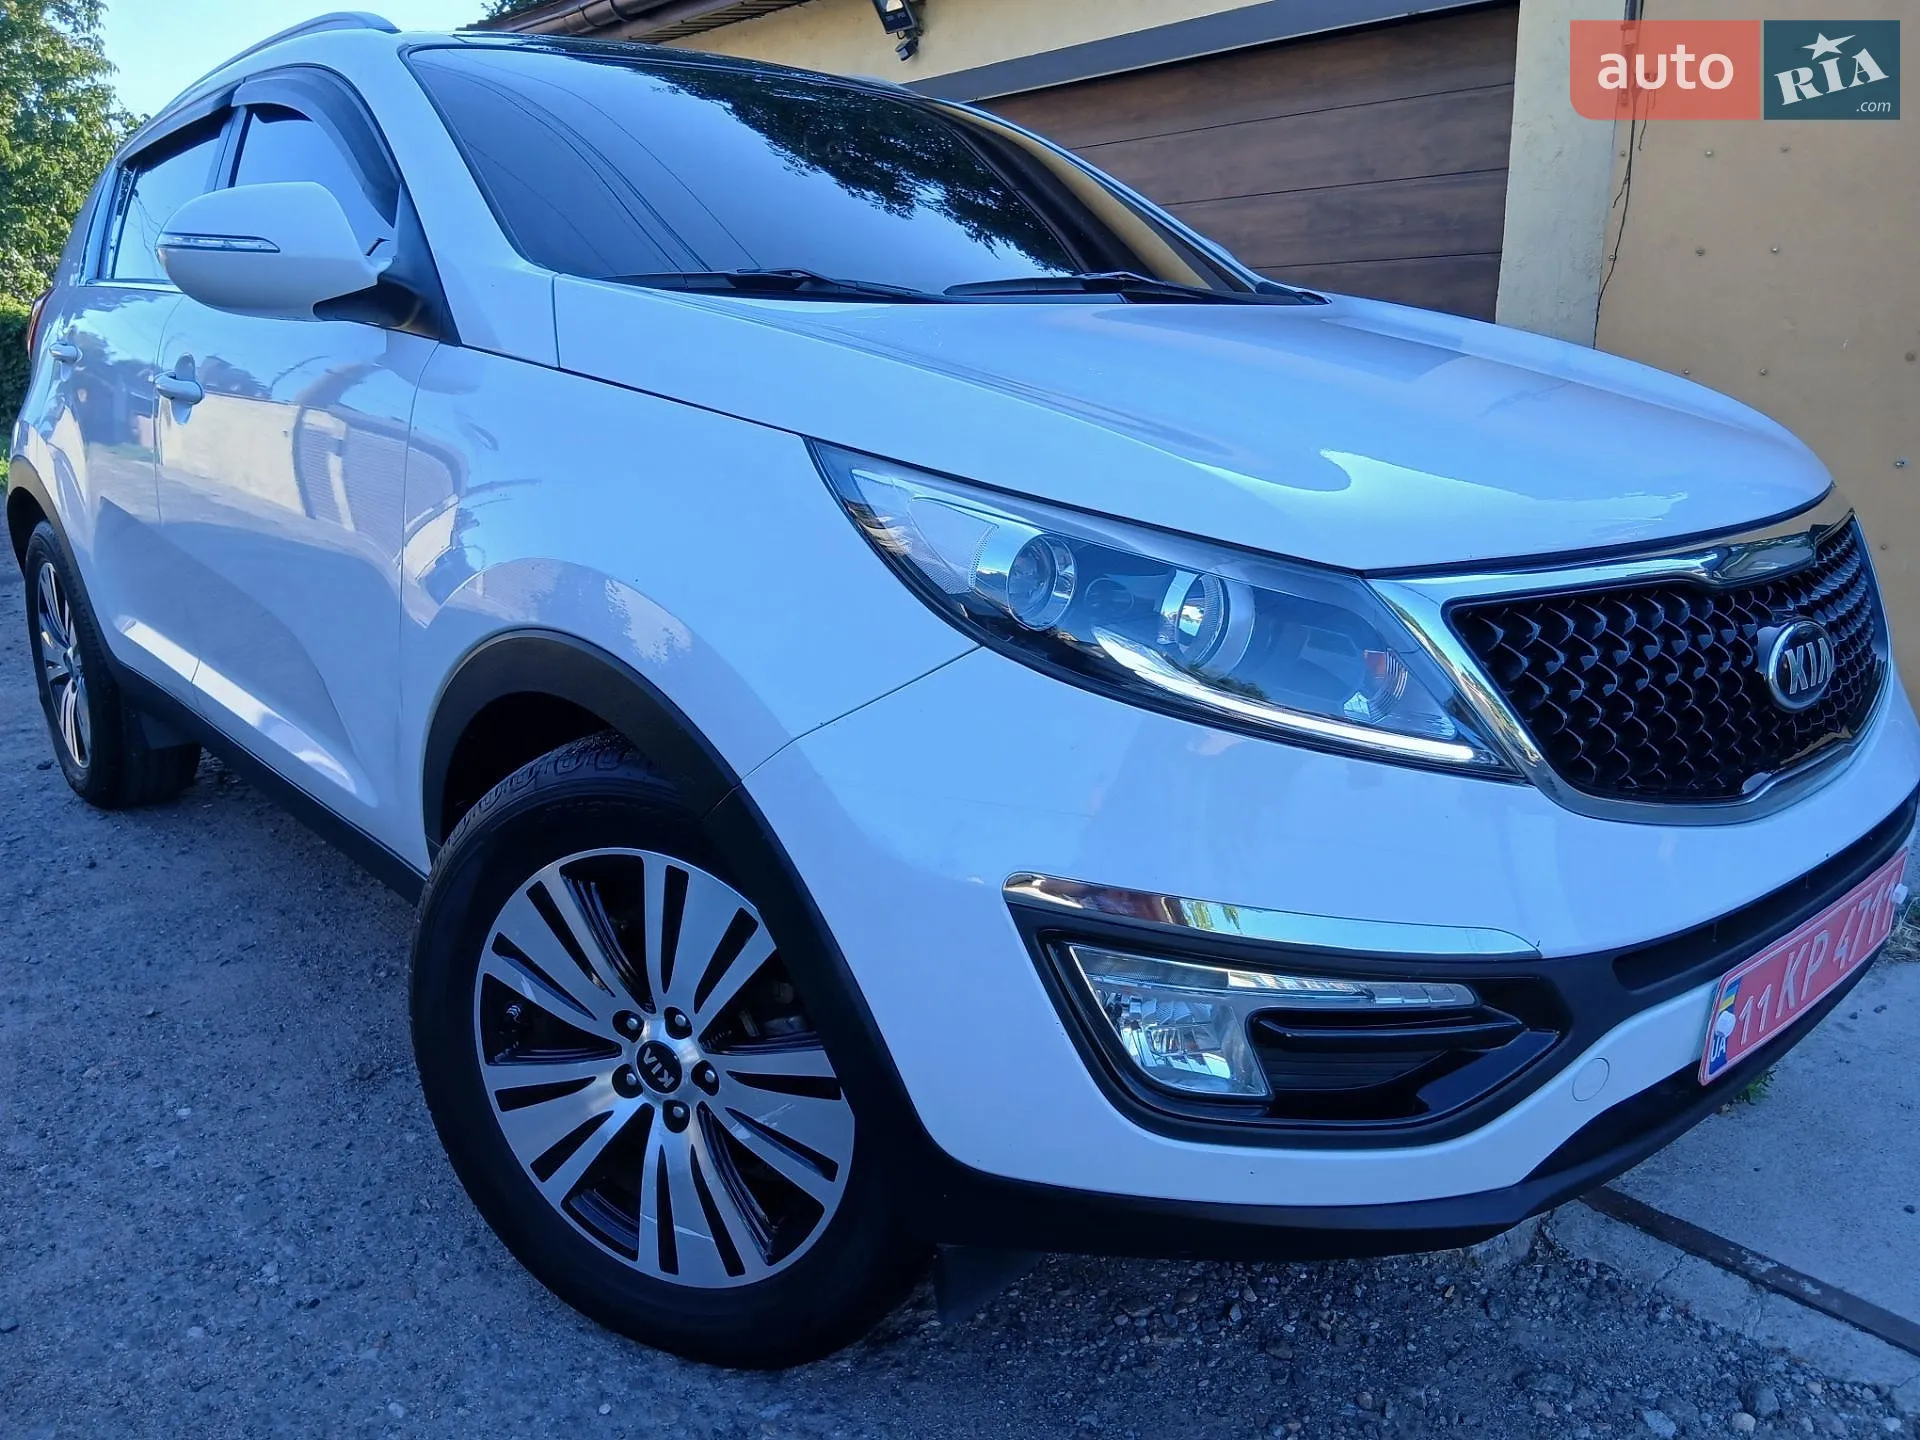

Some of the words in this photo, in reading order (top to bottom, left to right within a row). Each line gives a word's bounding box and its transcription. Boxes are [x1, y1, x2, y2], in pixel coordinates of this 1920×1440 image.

[1784, 637, 1832, 694] KIA
[643, 1047, 675, 1088] KIA
[1710, 1036, 1727, 1063] UA
